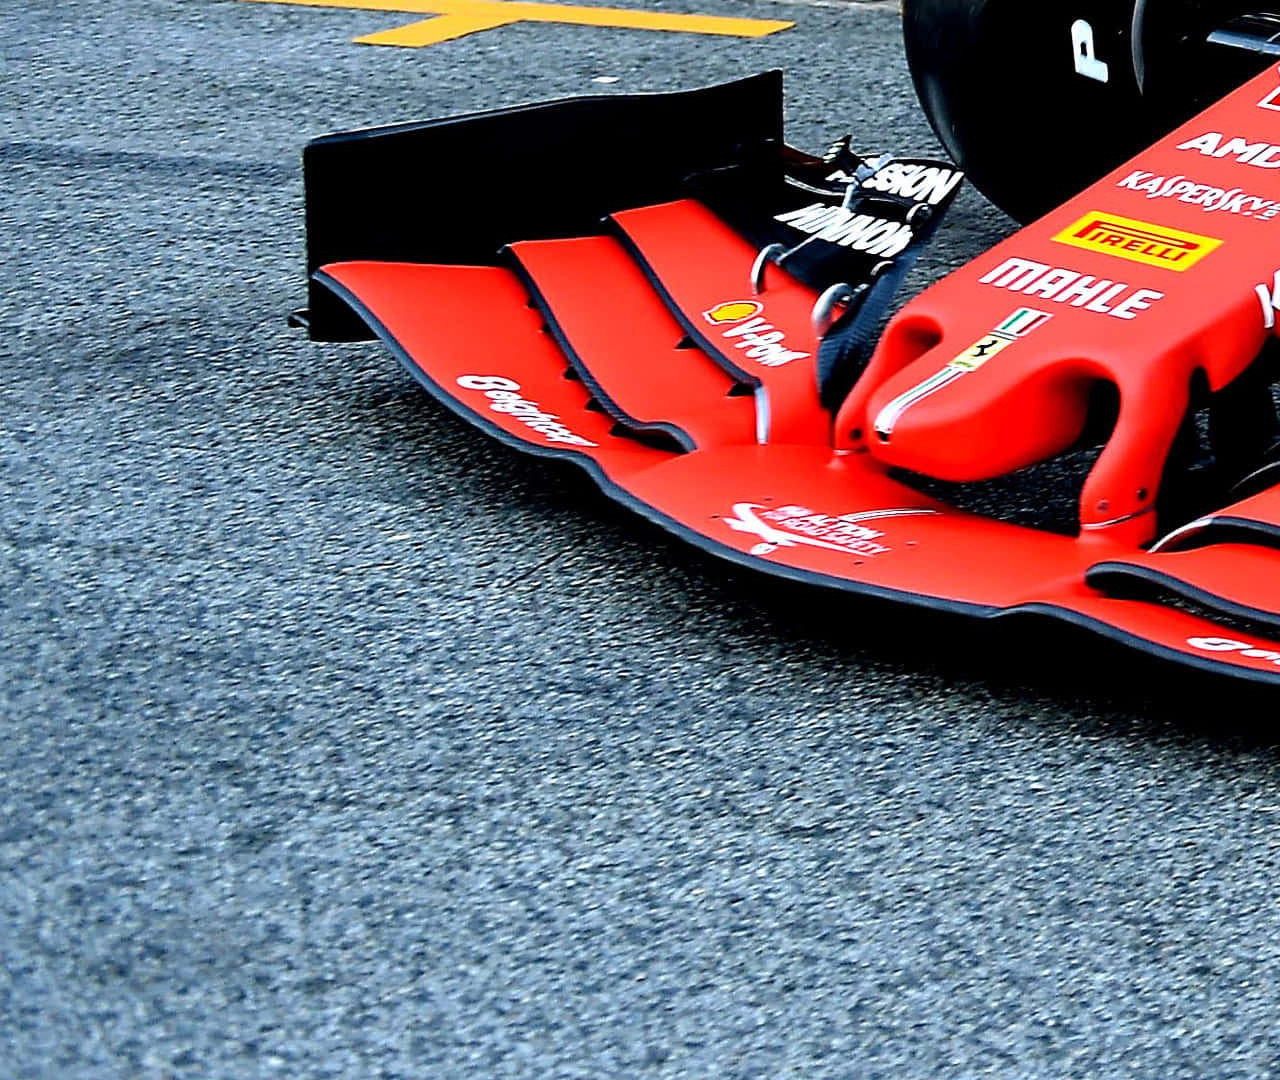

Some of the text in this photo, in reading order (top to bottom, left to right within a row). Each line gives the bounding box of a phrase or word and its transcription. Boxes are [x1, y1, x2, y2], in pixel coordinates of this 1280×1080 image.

[1071, 19, 1108, 82] P
[1116, 170, 1274, 216] KASPERSKY
[1074, 219, 1202, 262] PIRELLI
[979, 258, 1165, 320] MAHLE
